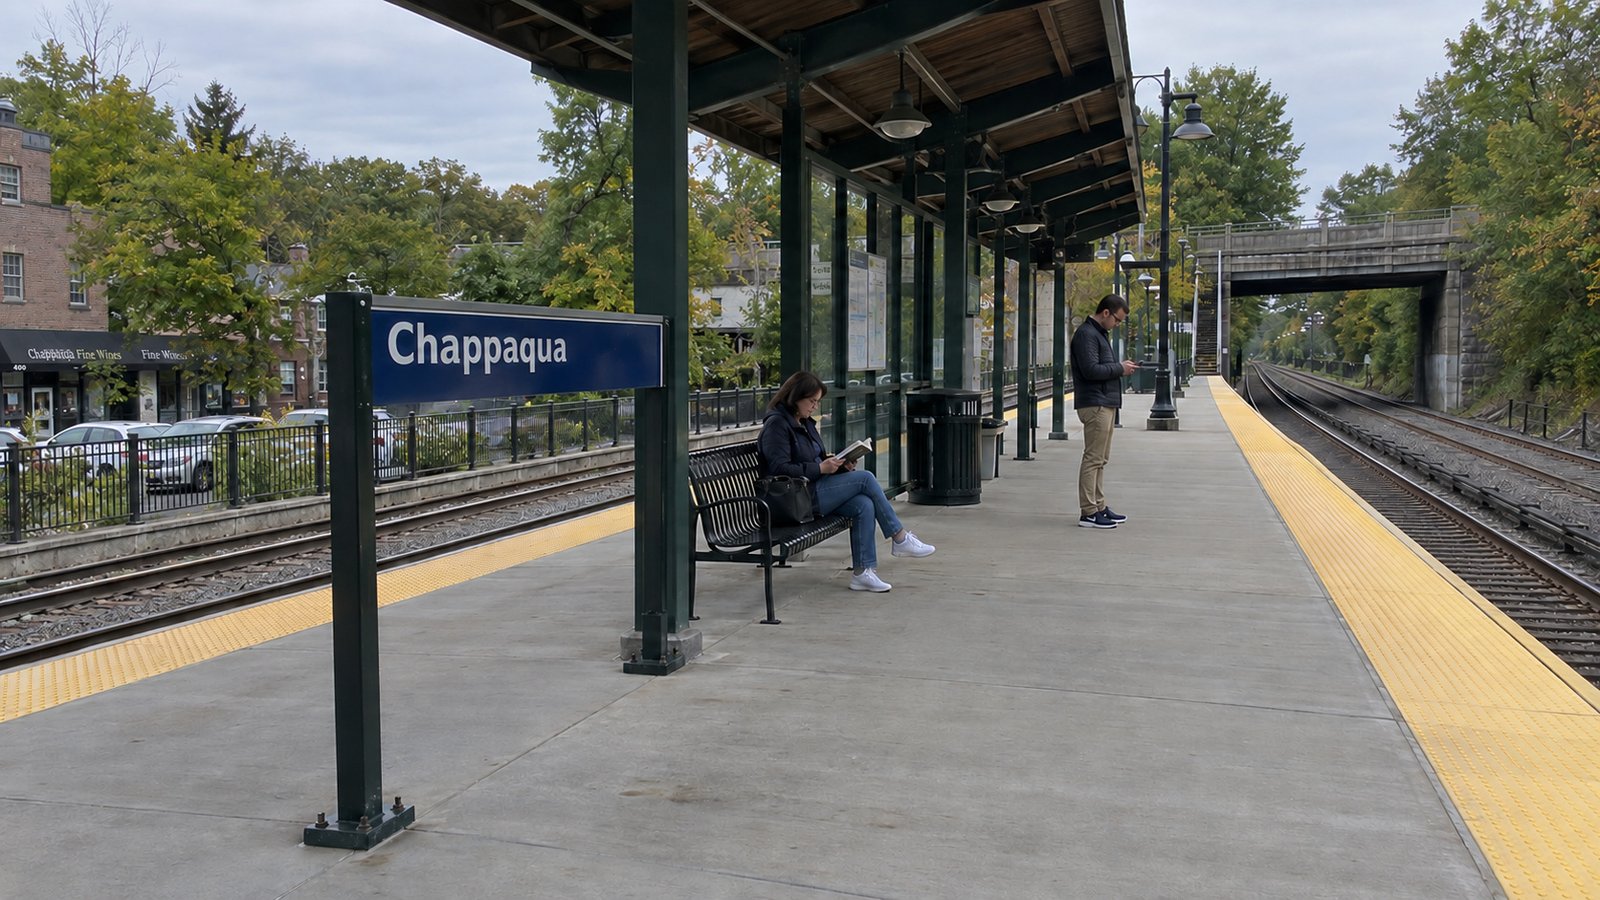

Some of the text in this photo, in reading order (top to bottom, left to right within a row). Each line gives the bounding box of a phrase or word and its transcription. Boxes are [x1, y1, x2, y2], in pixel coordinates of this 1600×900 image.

[76, 348, 96, 360] Fine
[96, 349, 122, 360] Wines
[387, 321, 567, 375] Chappaqua
[141, 349, 160, 360] Fine
